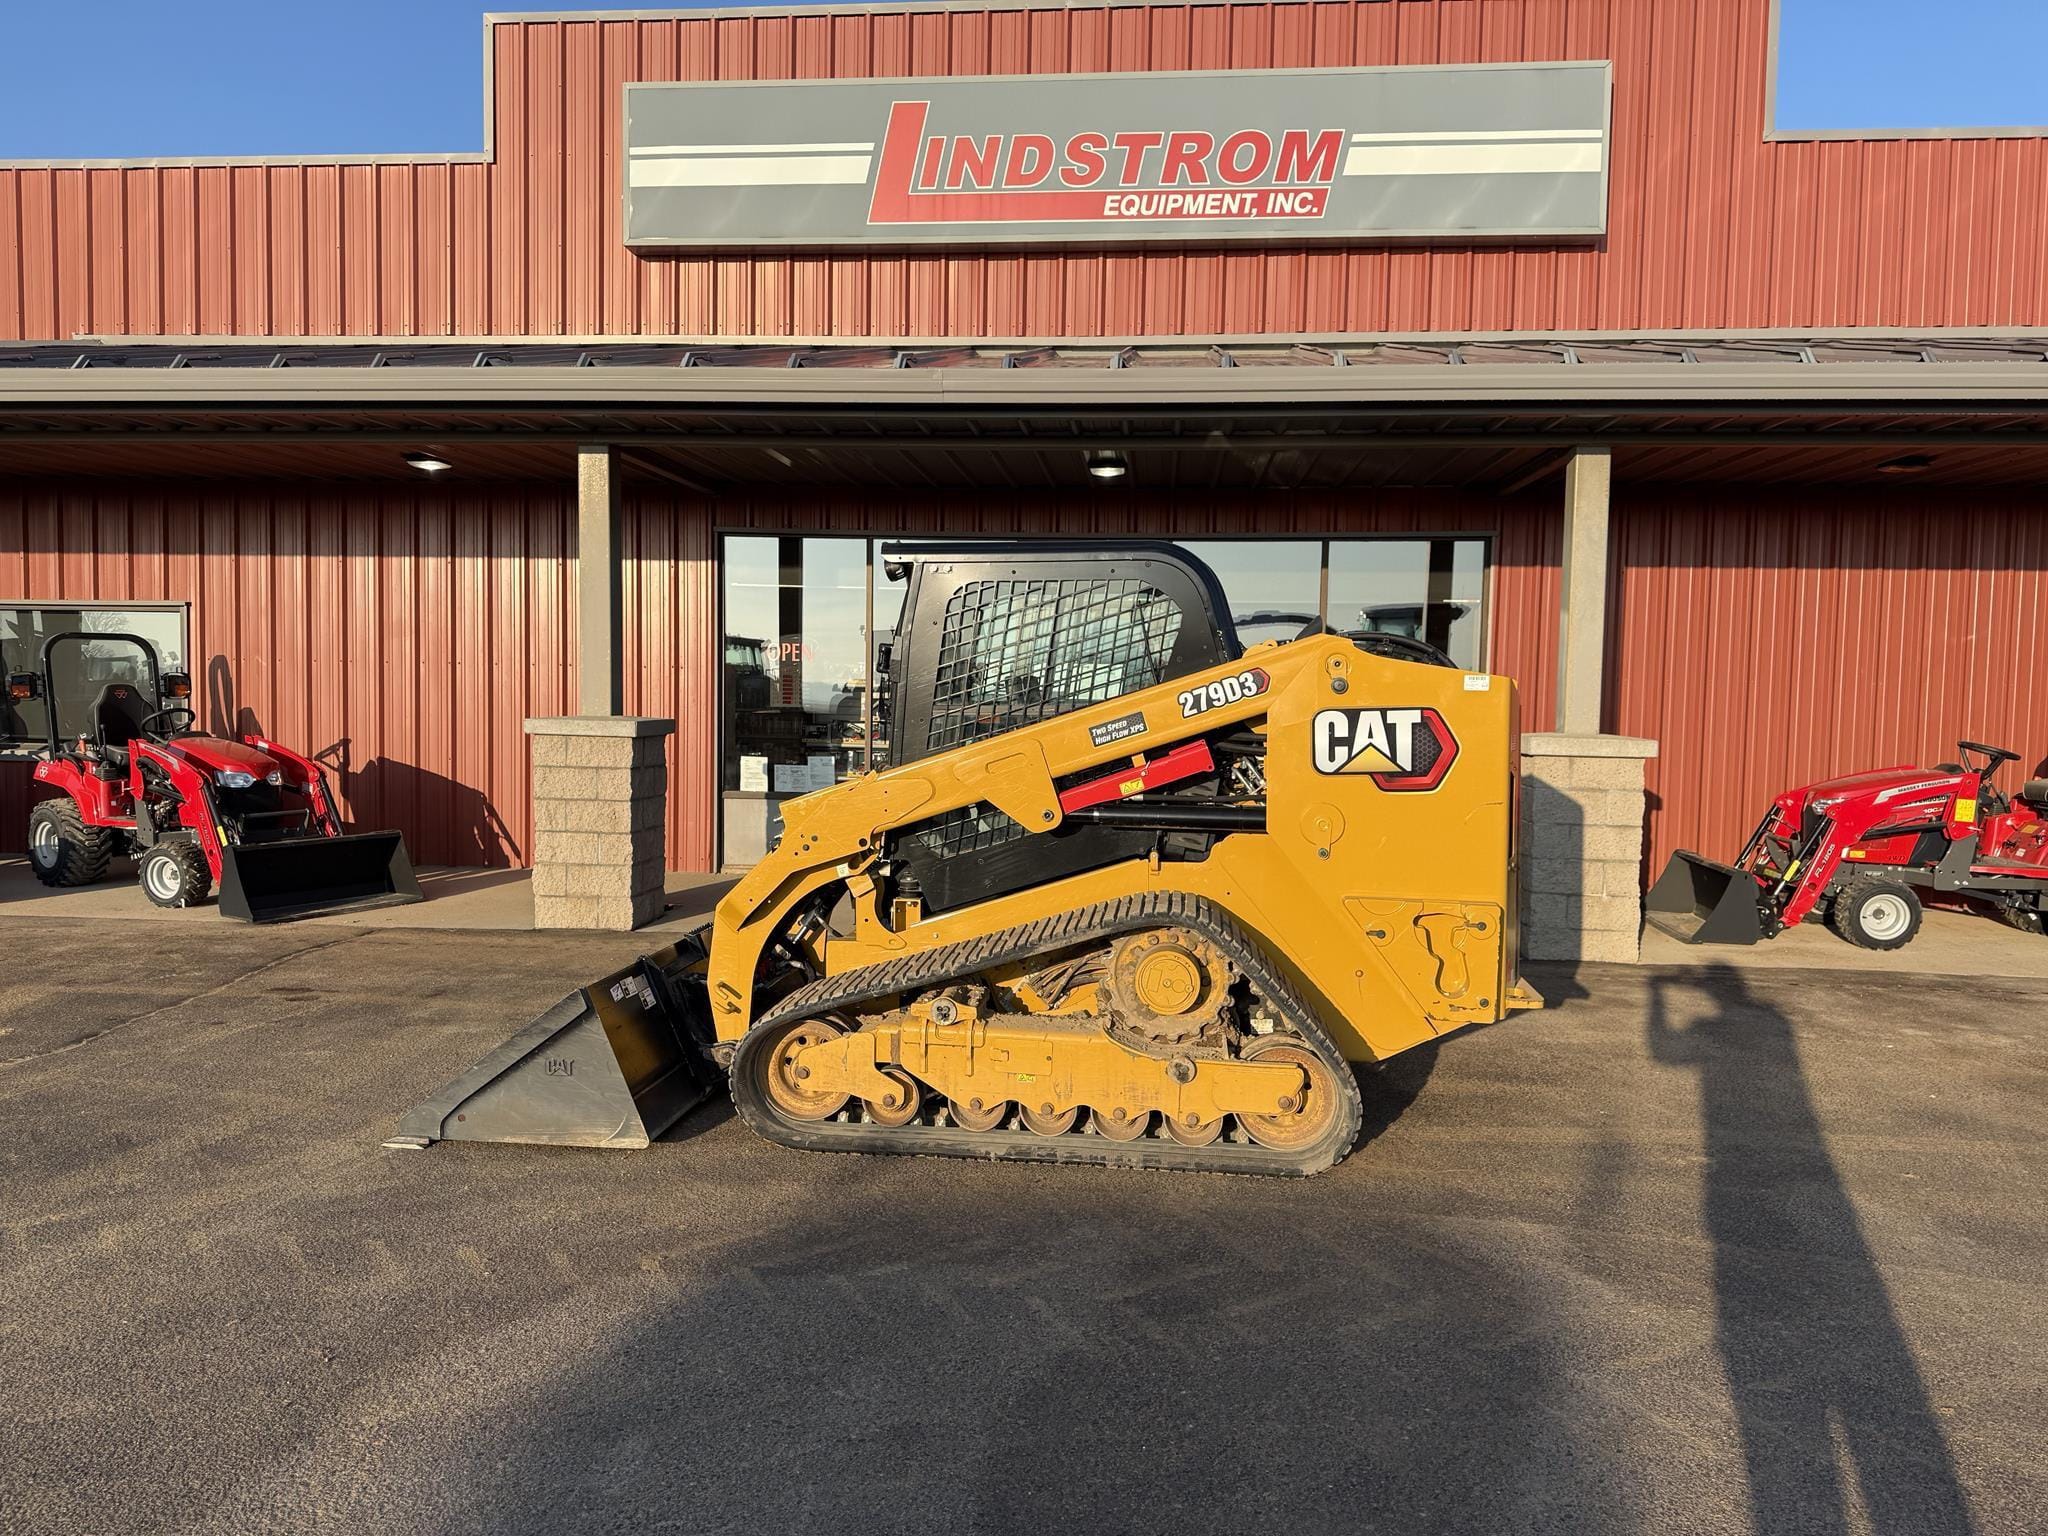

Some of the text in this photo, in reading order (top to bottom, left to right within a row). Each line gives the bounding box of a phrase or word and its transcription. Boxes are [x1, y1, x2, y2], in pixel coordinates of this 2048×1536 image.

[867, 100, 1345, 224] LINDSTROM
[1104, 192, 1319, 218] EQUIPMENT, INC.
[767, 642, 815, 664] OPEN
[1178, 672, 1258, 718] 279D3
[1130, 723, 1145, 734] XPS
[1314, 709, 1422, 773] CAT
[1897, 780, 1951, 793] MASSEY FERGUSON
[545, 1059, 574, 1076] CAT
